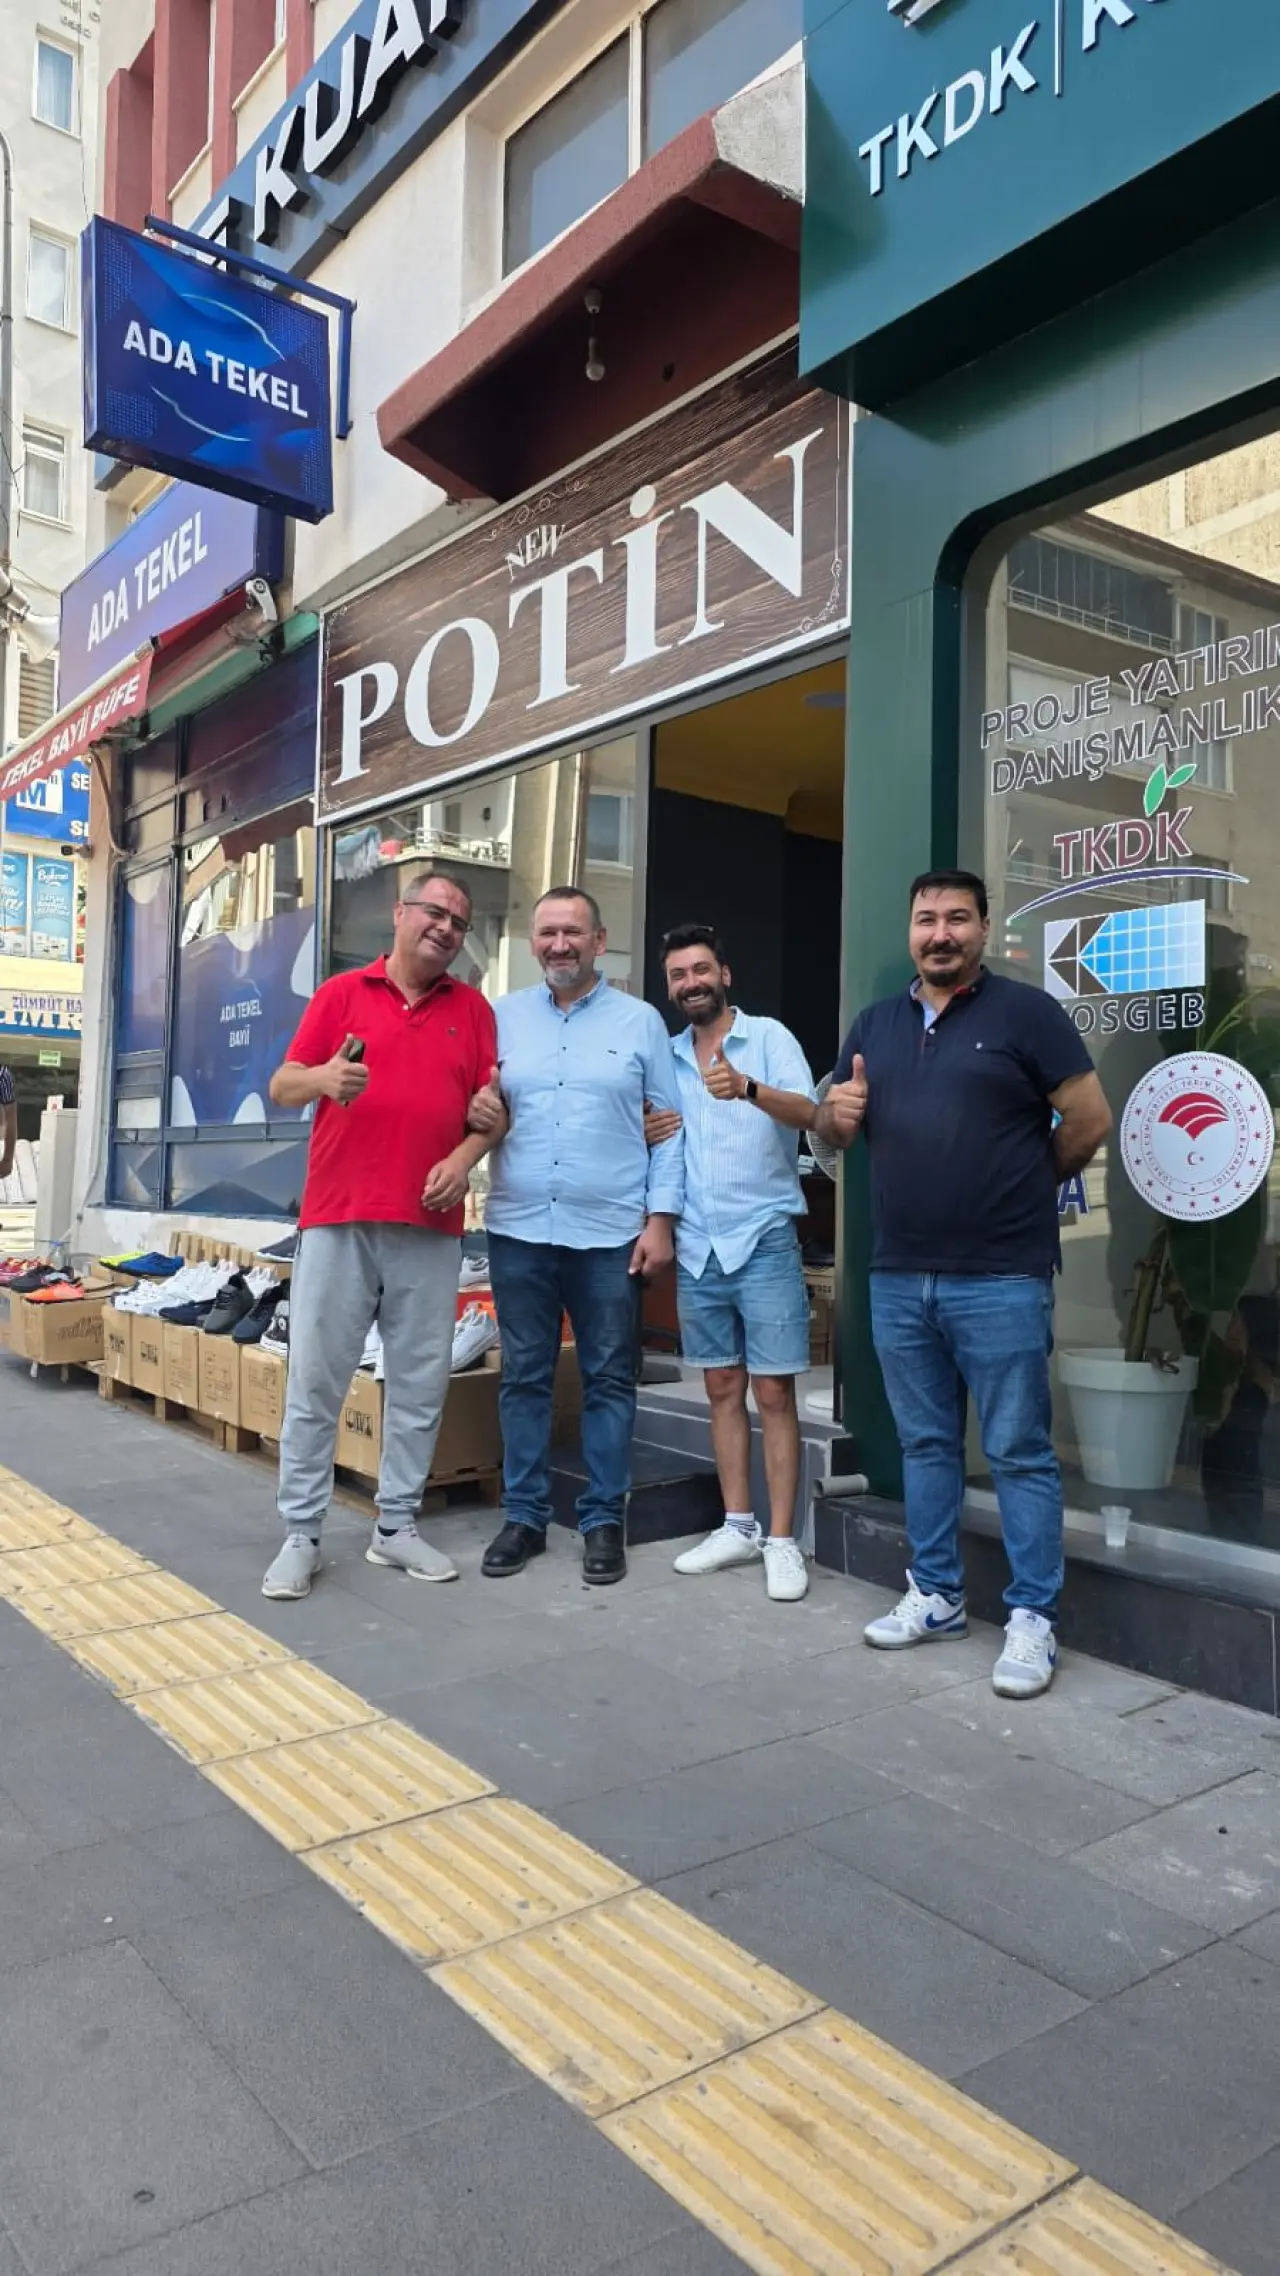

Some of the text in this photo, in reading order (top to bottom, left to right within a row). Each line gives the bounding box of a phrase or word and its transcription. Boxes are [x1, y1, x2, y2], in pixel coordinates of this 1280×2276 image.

[254, 0, 460, 243] KUA
[858, 20, 1039, 196] TKDK
[123, 320, 308, 418] ADA TEKEL
[87, 511, 209, 652] ADA TEKEL
[505, 524, 566, 583] NEW
[331, 427, 825, 787] POTİN
[1, 746, 45, 791] TEKEL
[90, 673, 141, 732] BÜFE
[980, 675, 1112, 750] PROJE
[989, 685, 1280, 796] DANIŞMANLIK
[1053, 806, 1194, 880] TKDK
[220, 998, 263, 1023] ADA TEKEL
[1066, 992, 1207, 1037] OSGEB
